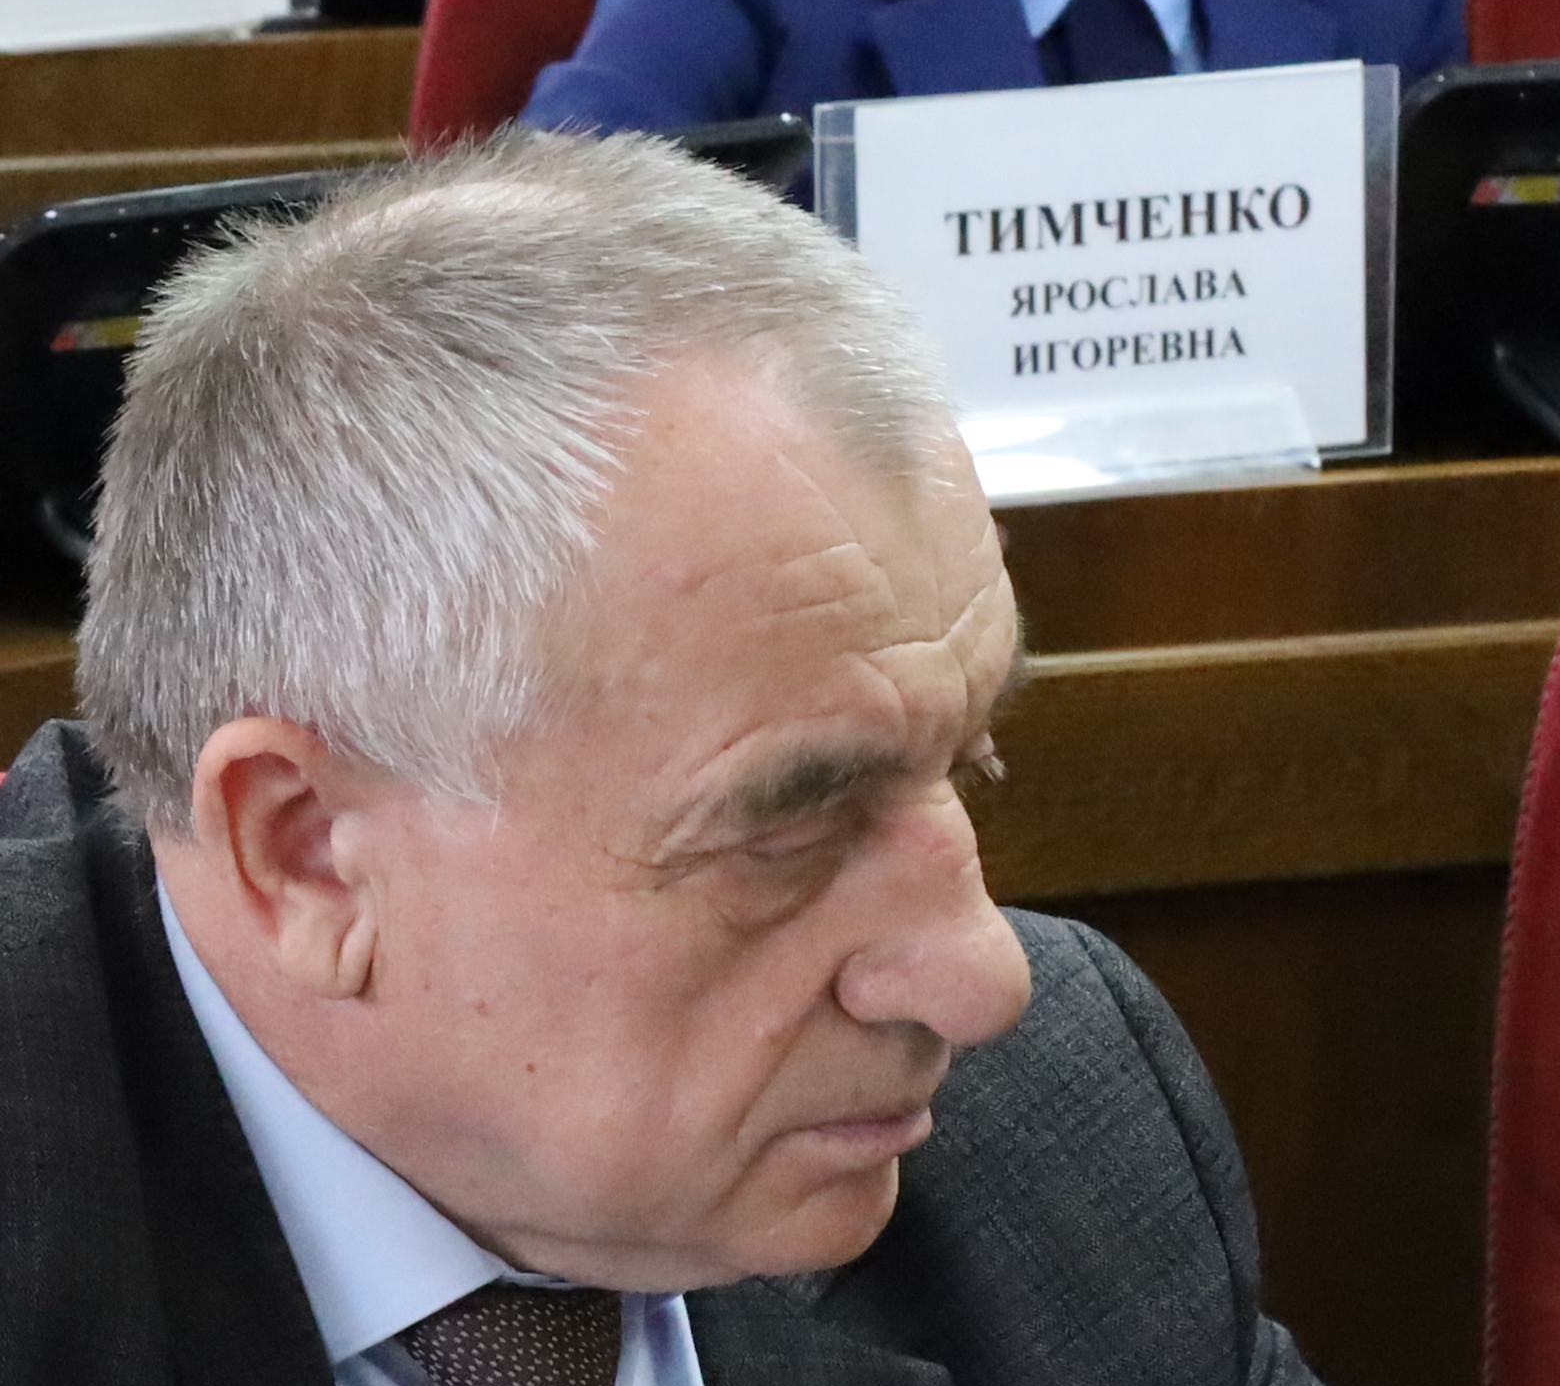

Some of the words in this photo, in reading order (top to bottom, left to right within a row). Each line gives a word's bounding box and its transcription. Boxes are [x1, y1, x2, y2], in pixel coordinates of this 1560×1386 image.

[944, 182, 1312, 256] ТИМЧЕНКО
[1010, 268, 1247, 317] ЯРОСЛАВА
[1013, 327, 1246, 376] ИГОРЕВНА
